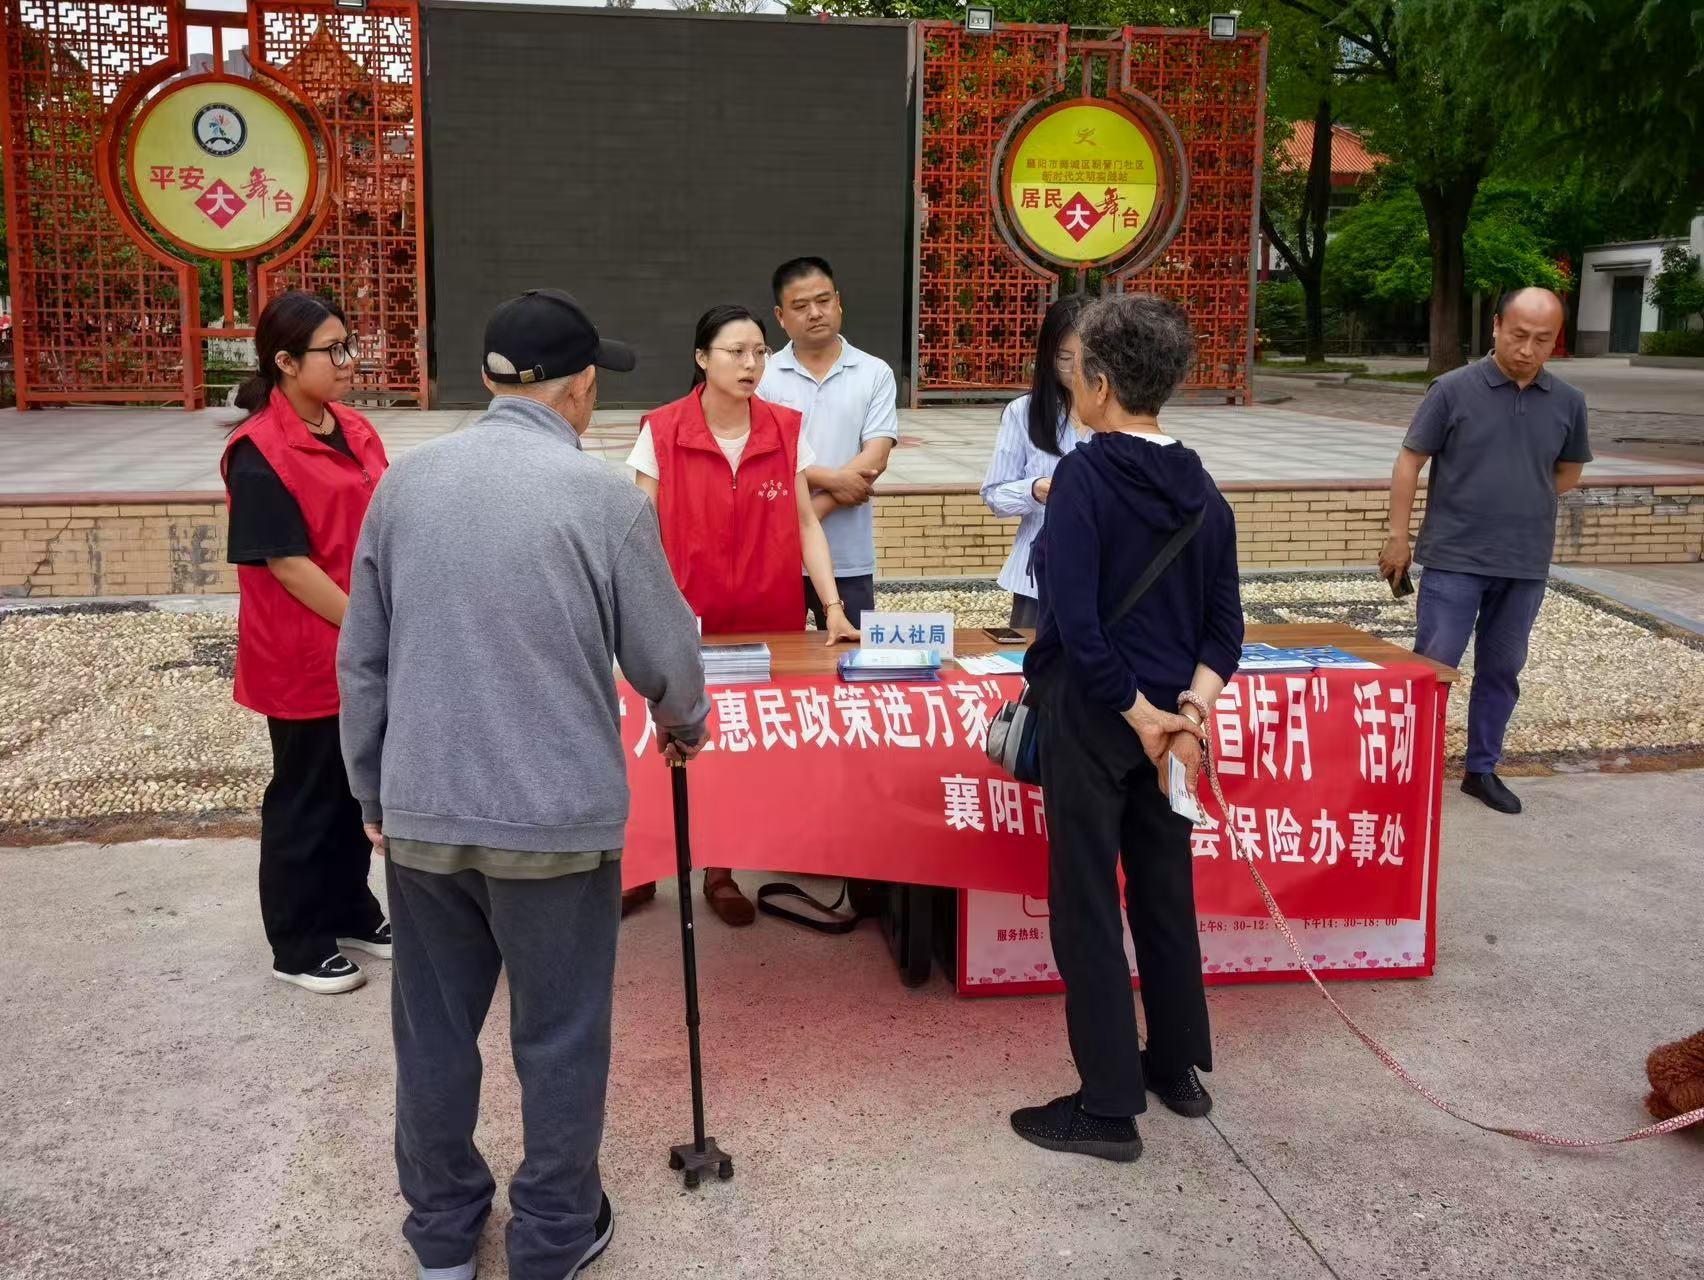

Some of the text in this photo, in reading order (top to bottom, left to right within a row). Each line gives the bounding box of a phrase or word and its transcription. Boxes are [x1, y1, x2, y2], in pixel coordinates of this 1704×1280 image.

[150, 165, 294, 219] 平安大舞台
[1042, 171, 1128, 182] 新时代文明实践站
[1020, 187, 1140, 232] 居民大舞台
[870, 623, 946, 645] 市人社局
[1353, 679, 1417, 785] 活动
